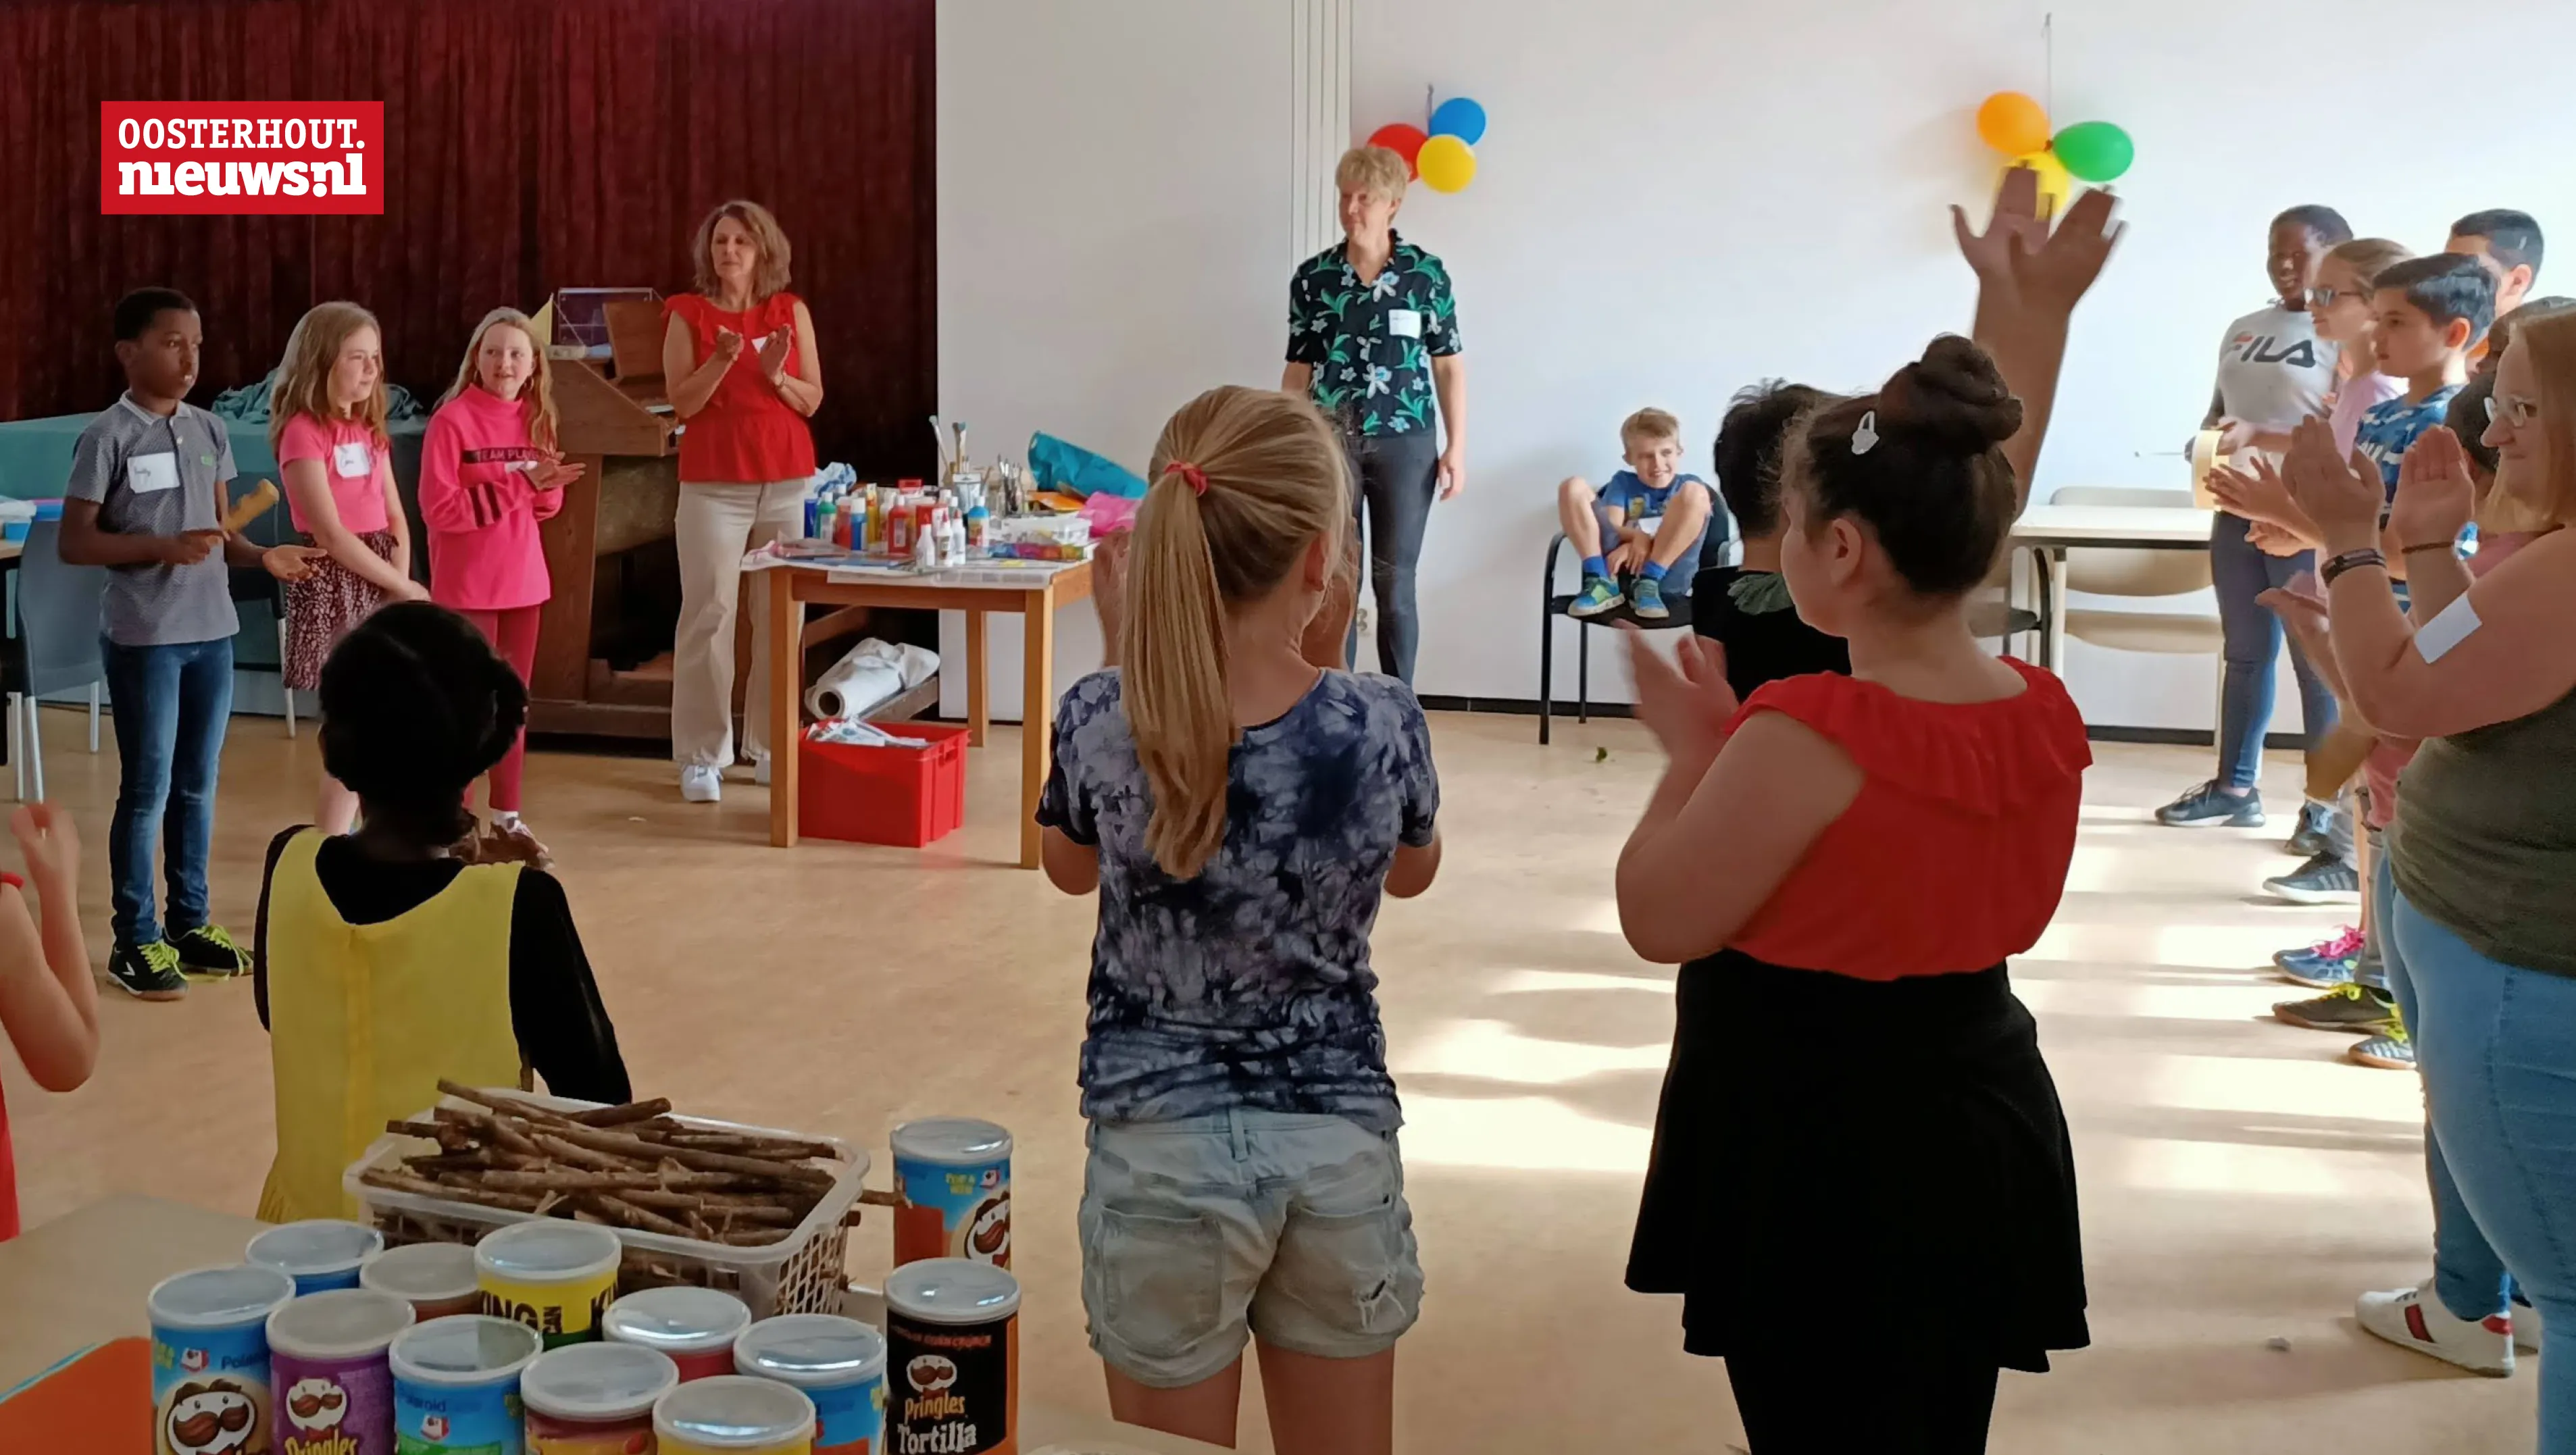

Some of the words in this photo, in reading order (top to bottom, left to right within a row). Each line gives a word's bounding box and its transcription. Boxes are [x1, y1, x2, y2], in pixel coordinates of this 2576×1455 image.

[2231, 334, 2316, 368] FILA
[476, 449, 505, 462] TEAM
[904, 1391, 965, 1425] Pringles
[284, 1427, 358, 1455] Pringles
[897, 1421, 977, 1454] Tortilla
